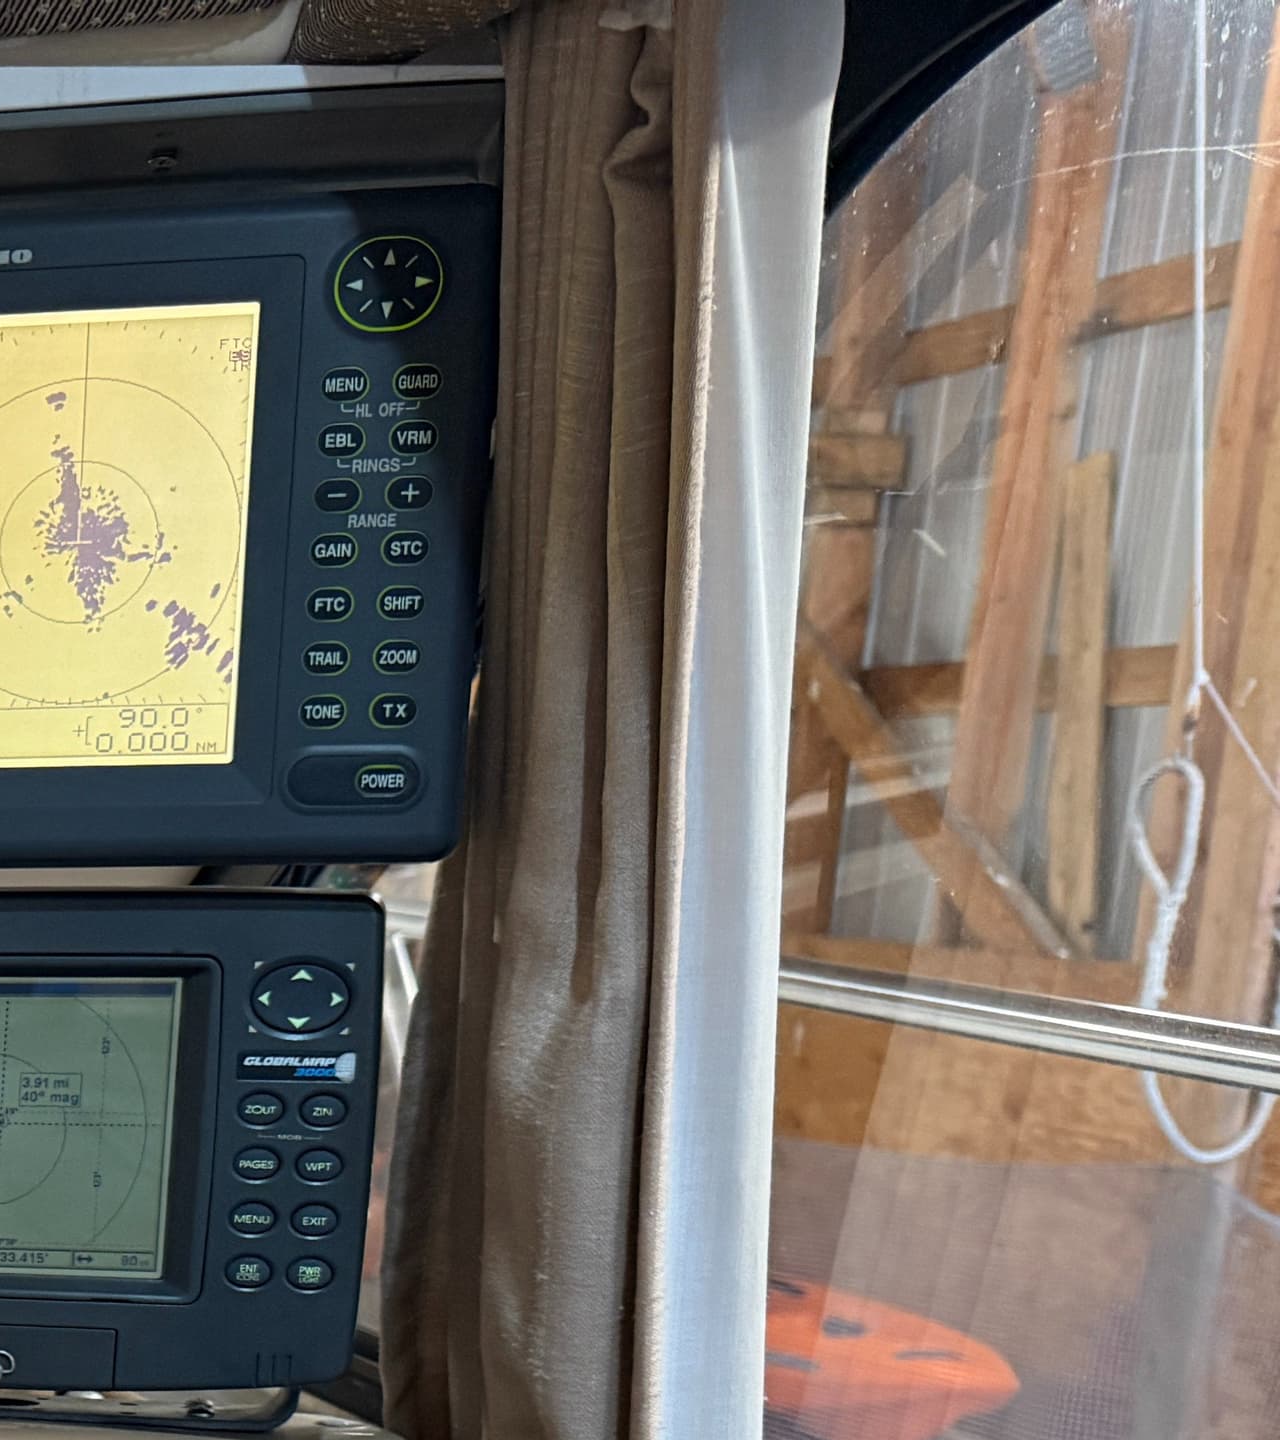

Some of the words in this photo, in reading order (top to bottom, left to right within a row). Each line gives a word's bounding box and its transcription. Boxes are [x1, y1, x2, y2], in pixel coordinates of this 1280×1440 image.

[220, 337, 252, 349] FTC
[325, 377, 364, 392] MENU
[398, 374, 439, 389] GUARD
[355, 403, 372, 418] HL
[378, 402, 406, 418] OFF
[325, 432, 356, 448] EBL
[397, 430, 432, 445] VRM
[351, 458, 401, 473] RINGS
[347, 513, 397, 528] RANGE
[315, 543, 352, 557] GAIN
[390, 541, 422, 556] STC
[314, 597, 345, 612] FTC
[383, 595, 421, 611] SHIFT
[308, 651, 344, 666] TRAIL
[379, 650, 416, 665] ZOOM
[304, 704, 341, 719] TONE
[383, 703, 407, 718] TX
[96, 731, 189, 754] 0.000
[196, 741, 217, 752] NM
[360, 774, 405, 789] POWER
[243, 1056, 337, 1067] GLOBALMAP
[21, 1077, 49, 1089] 3.91
[53, 1077, 70, 1089] mi
[50, 1093, 80, 1106] mag
[245, 1104, 277, 1115] ZOUT
[312, 1106, 333, 1117] ZIN
[239, 1160, 274, 1170] PAGES
[305, 1162, 332, 1172] WPT
[234, 1214, 271, 1225] MENU
[302, 1216, 328, 1226] EXIT
[240, 1263, 258, 1273] ENT
[299, 1266, 321, 1275] PWR
